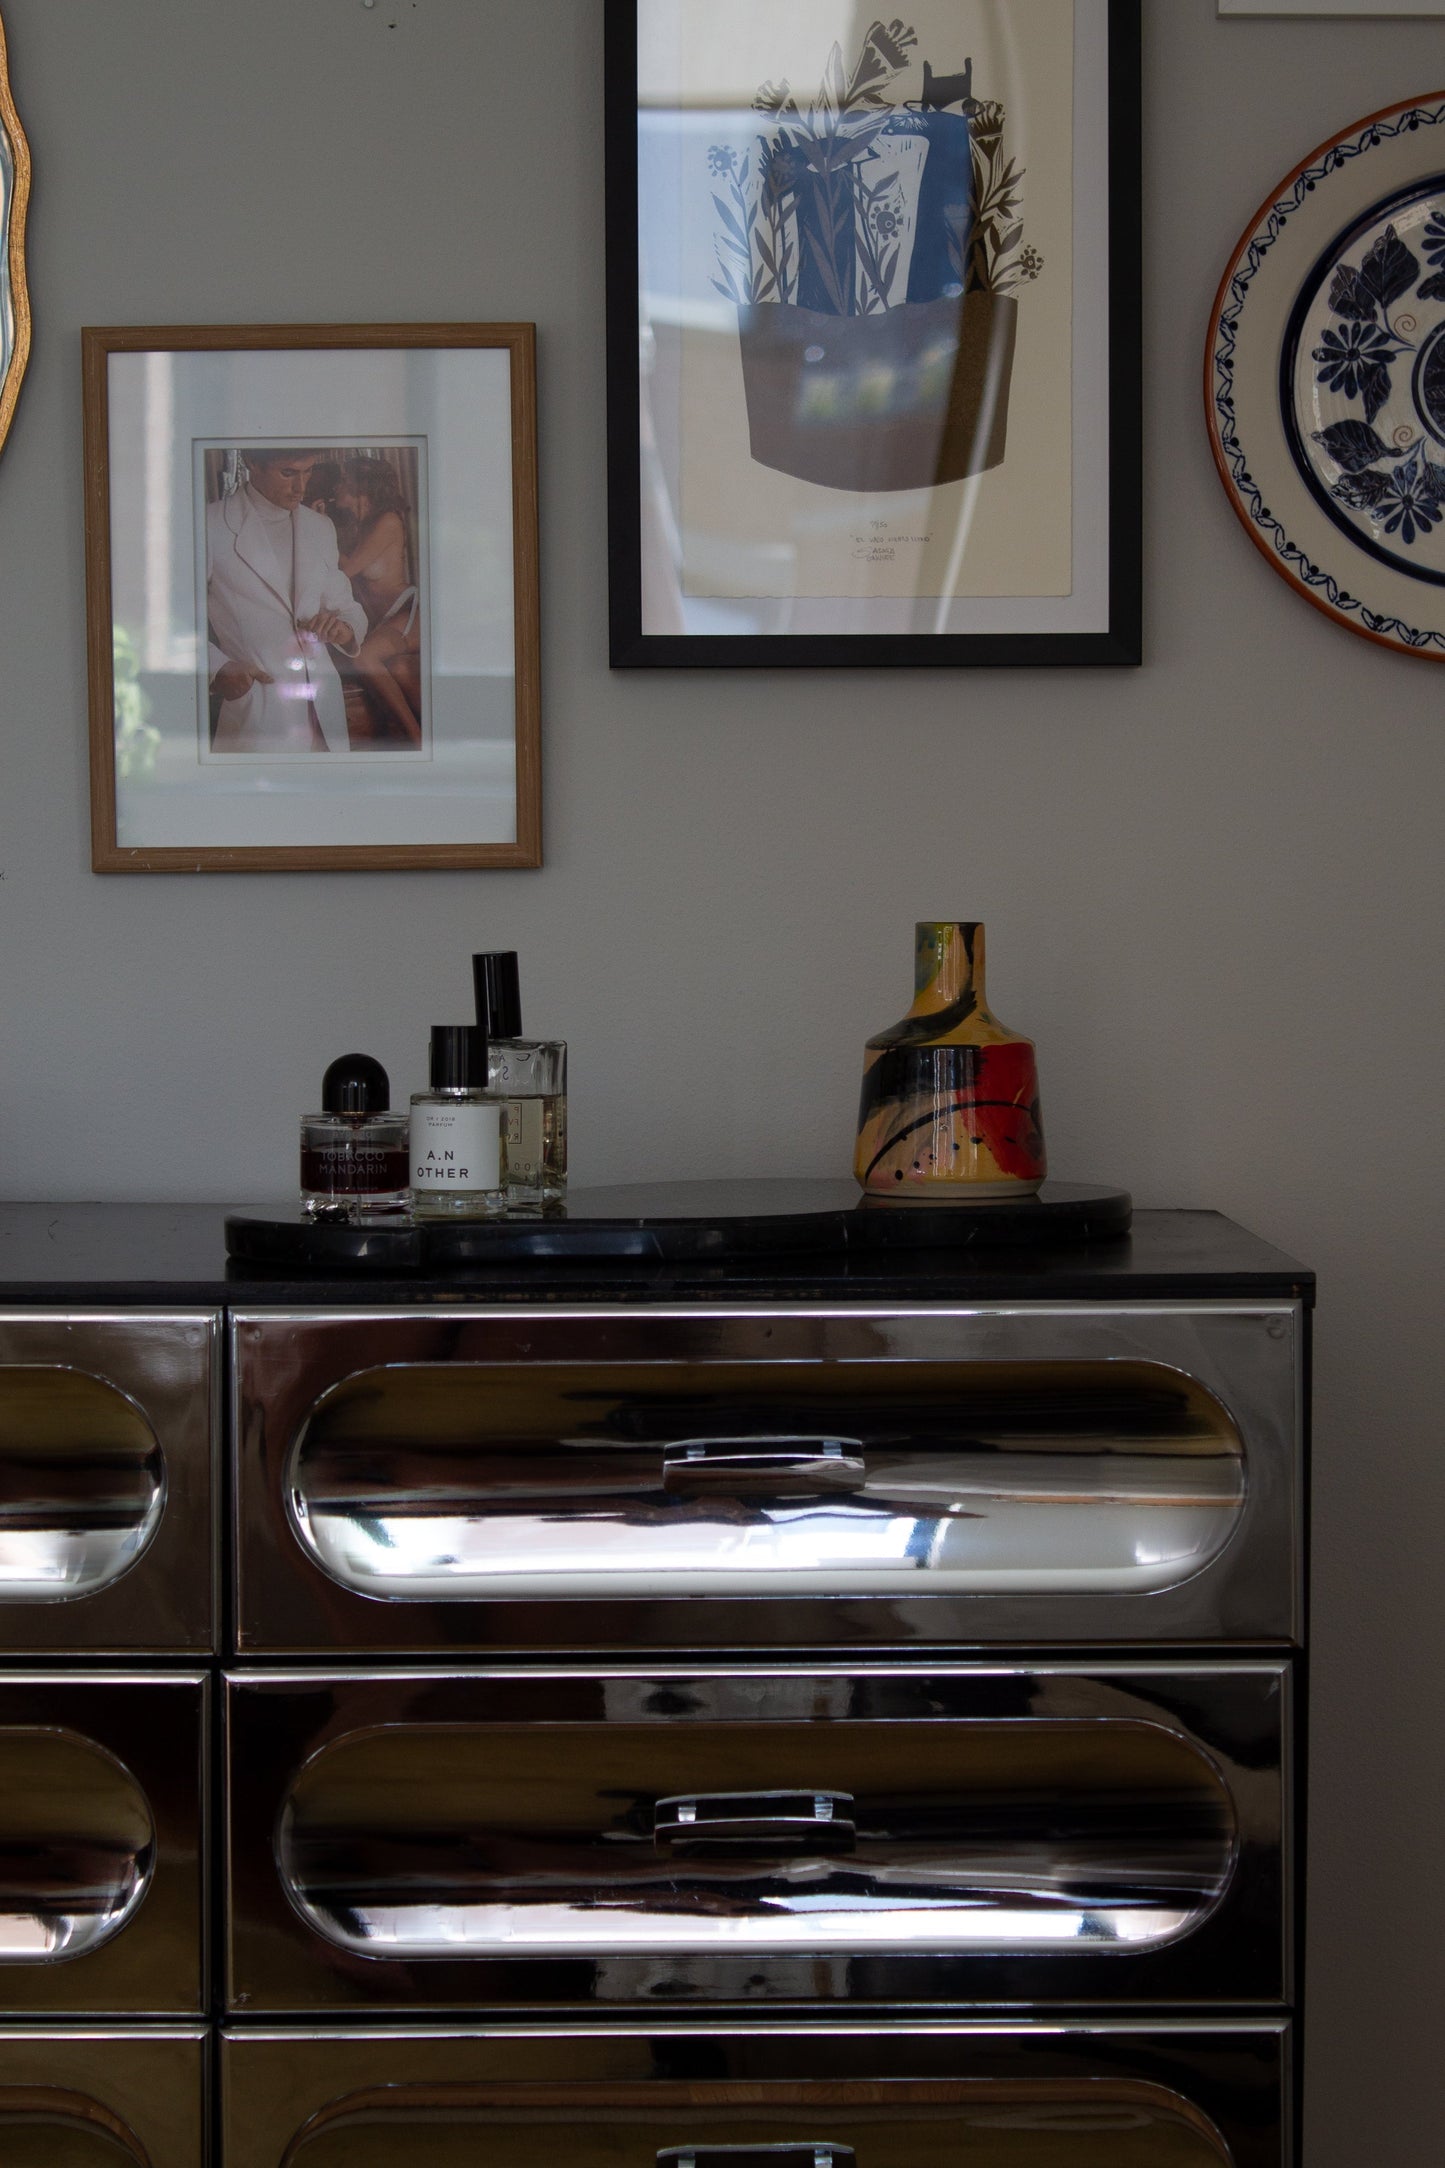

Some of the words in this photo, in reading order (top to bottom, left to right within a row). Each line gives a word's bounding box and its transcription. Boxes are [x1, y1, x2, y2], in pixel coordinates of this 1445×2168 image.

[321, 1151, 385, 1161] TOBACCO
[427, 1150, 454, 1160] A.N
[319, 1164, 388, 1174] MANDARIN
[417, 1167, 469, 1178] OTHER
